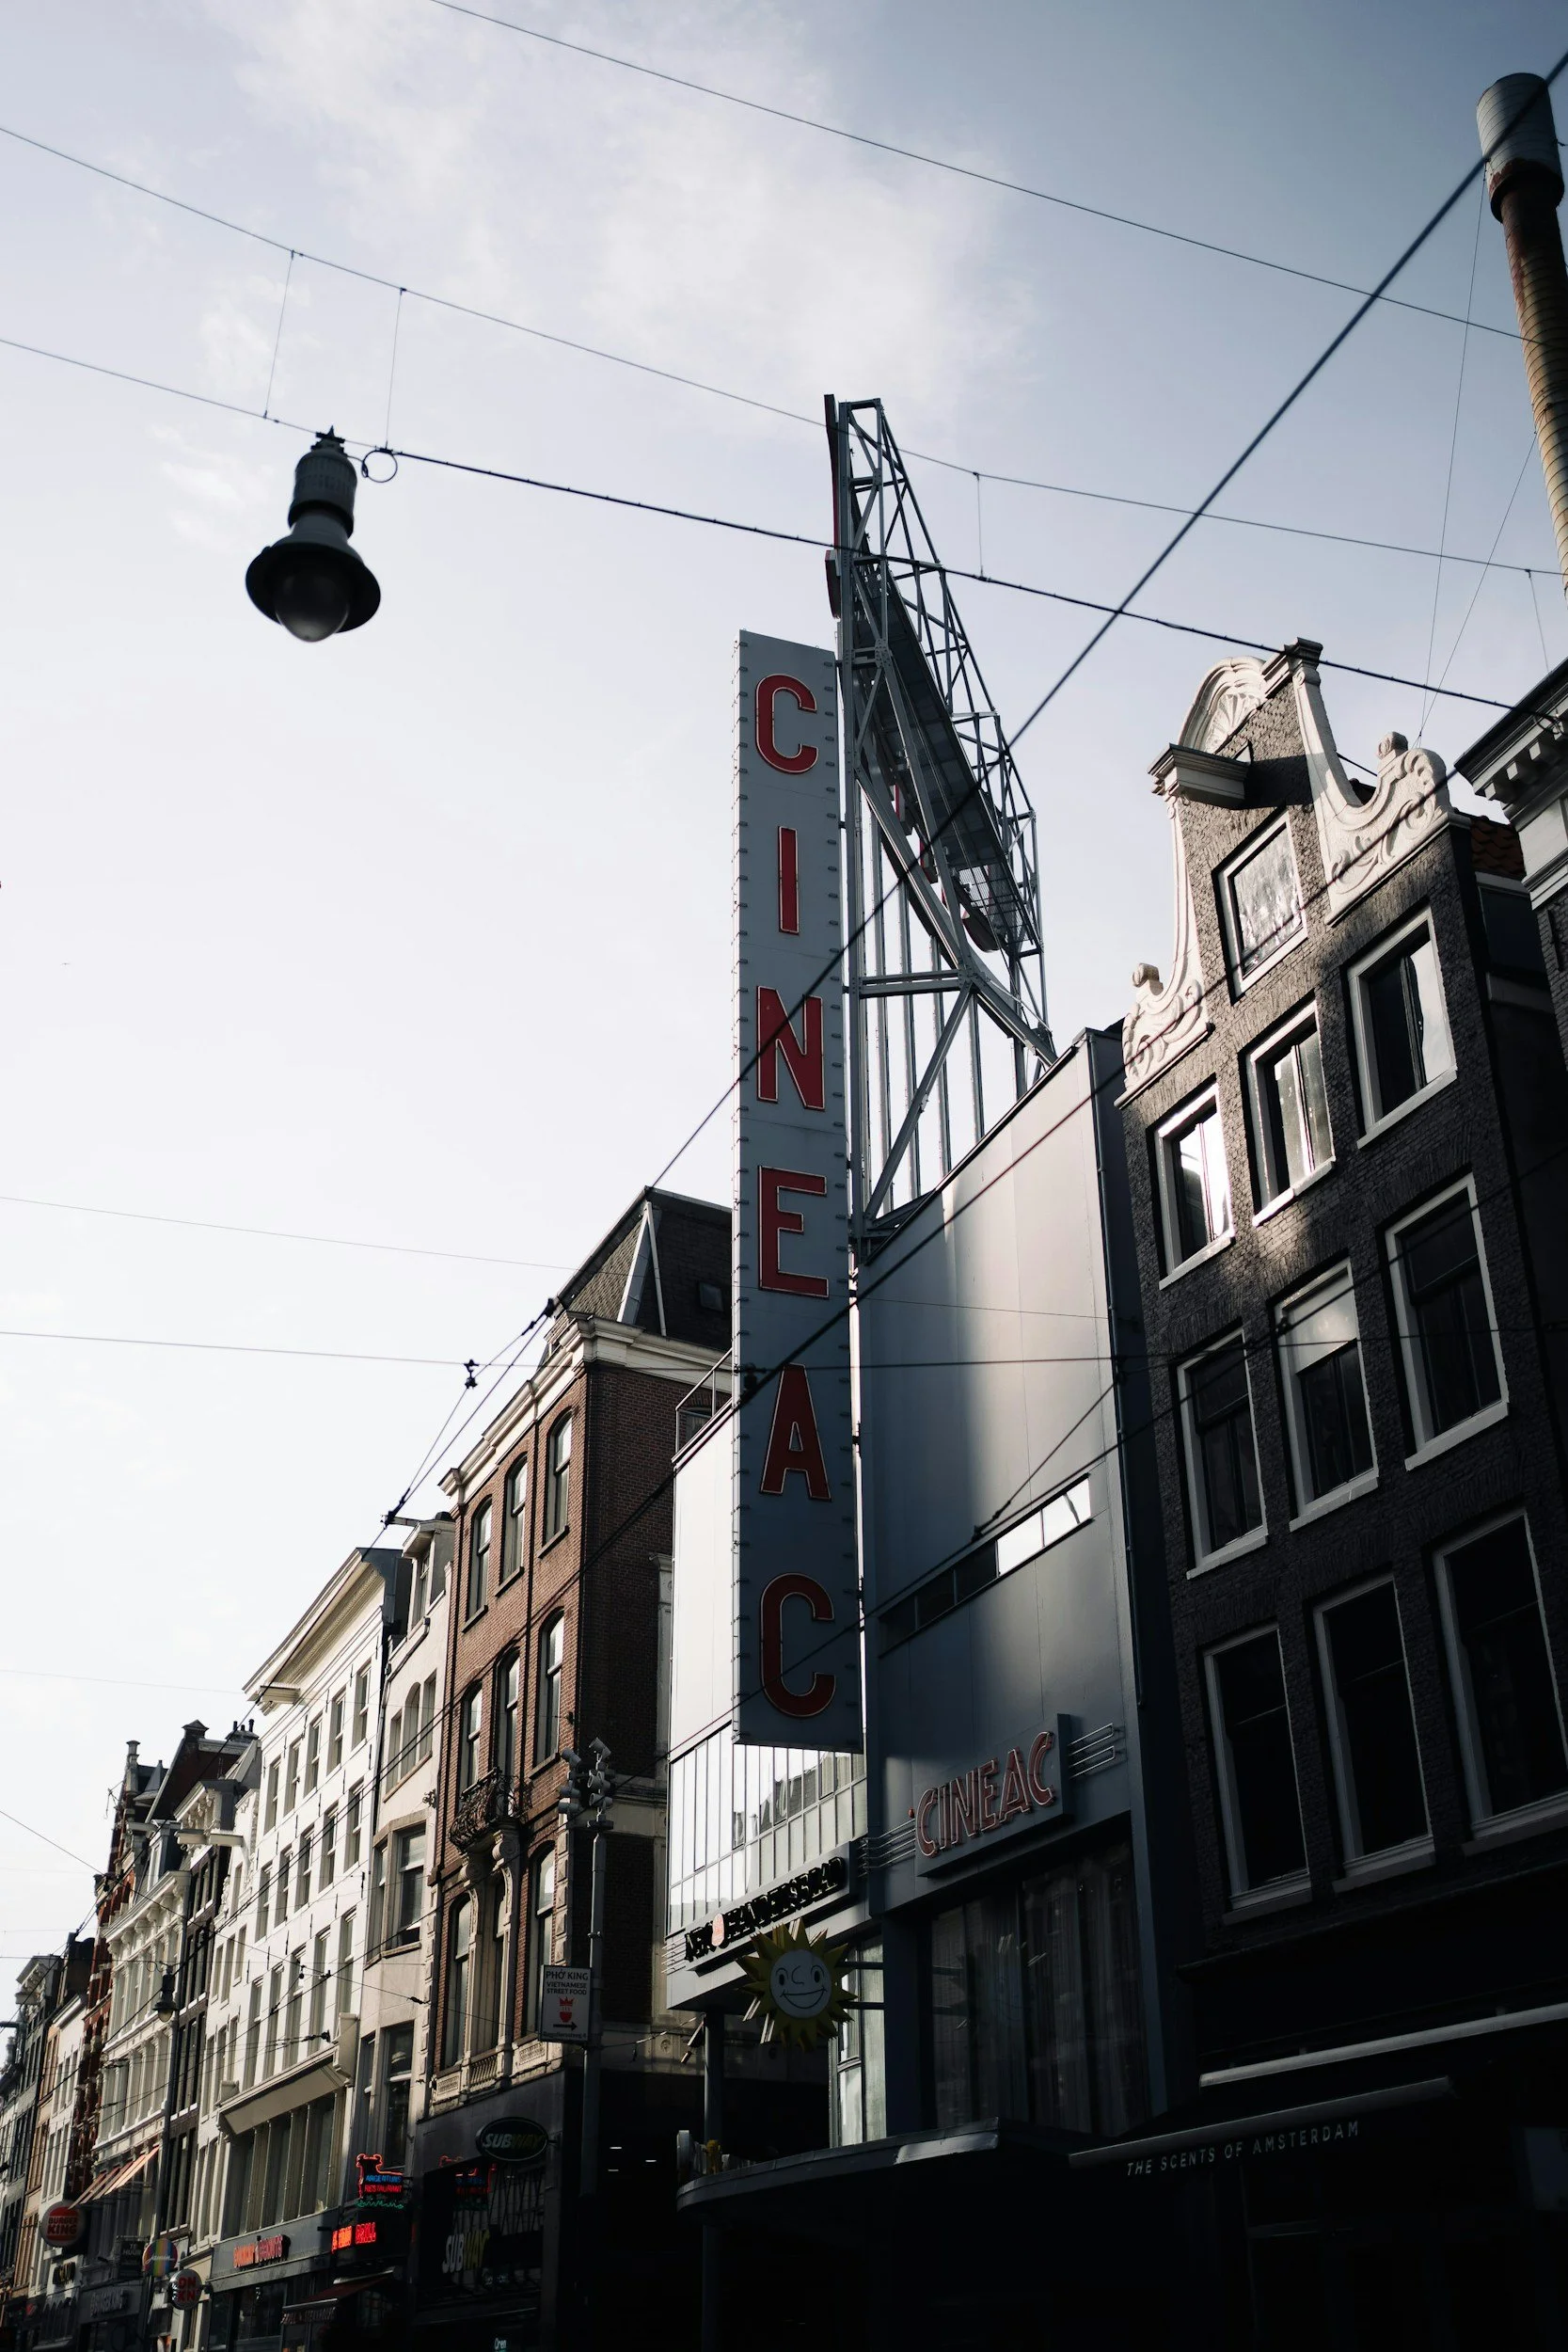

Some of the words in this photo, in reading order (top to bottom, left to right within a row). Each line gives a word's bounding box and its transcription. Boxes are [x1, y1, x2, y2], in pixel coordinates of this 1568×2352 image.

[755, 674, 836, 1718] CINEAC
[915, 1731, 1056, 1858] CINEAC
[567, 1972, 589, 1980] KING
[483, 2133, 545, 2150] SUBWAY
[1126, 2159, 1152, 2176] THE
[1160, 2148, 1215, 2171] SCENTS
[1224, 2141, 1243, 2159] OF
[1252, 2120, 1360, 2155] AMSTERDAM
[47, 2223, 77, 2235] KING
[441, 2230, 491, 2275] SUBWAY
